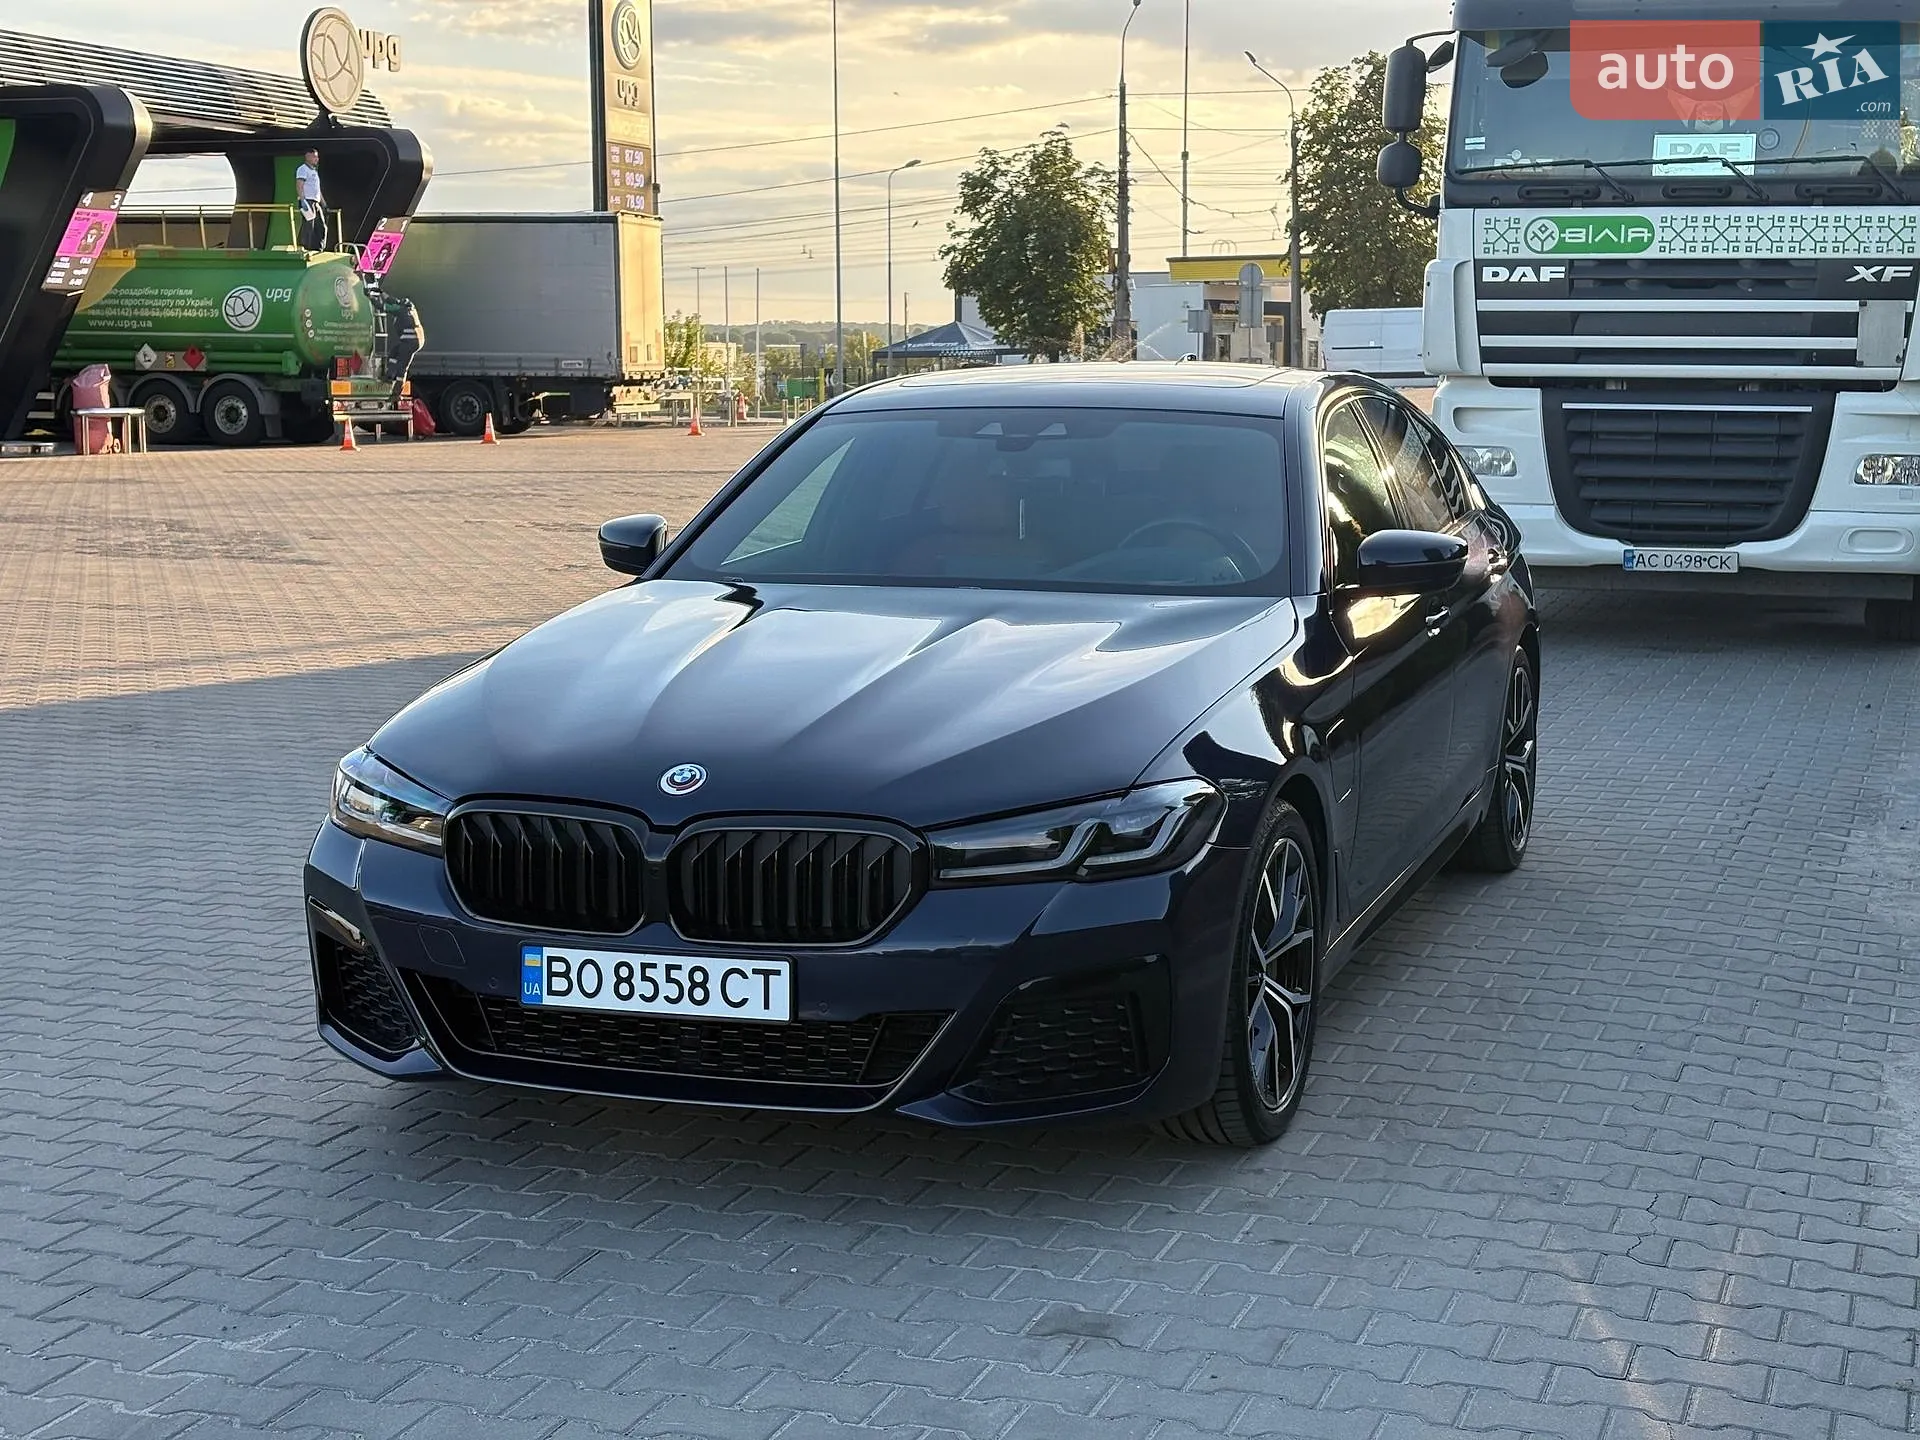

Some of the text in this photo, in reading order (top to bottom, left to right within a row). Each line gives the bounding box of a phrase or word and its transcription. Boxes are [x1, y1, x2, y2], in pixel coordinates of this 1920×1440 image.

[359, 28, 401, 72] upg
[1669, 142, 1741, 156] DAF
[82, 192, 121, 209] 4 3
[377, 217, 408, 232] 2 1
[1482, 265, 1566, 283] DAF
[1846, 265, 1913, 282] XF
[186, 296, 213, 308] Україні
[266, 287, 293, 302] upg
[88, 319, 153, 329] www.upg.ua
[1635, 553, 1732, 570] AC 0498 CK
[524, 982, 541, 996] UA
[546, 956, 782, 1010] BO 8558 CT
